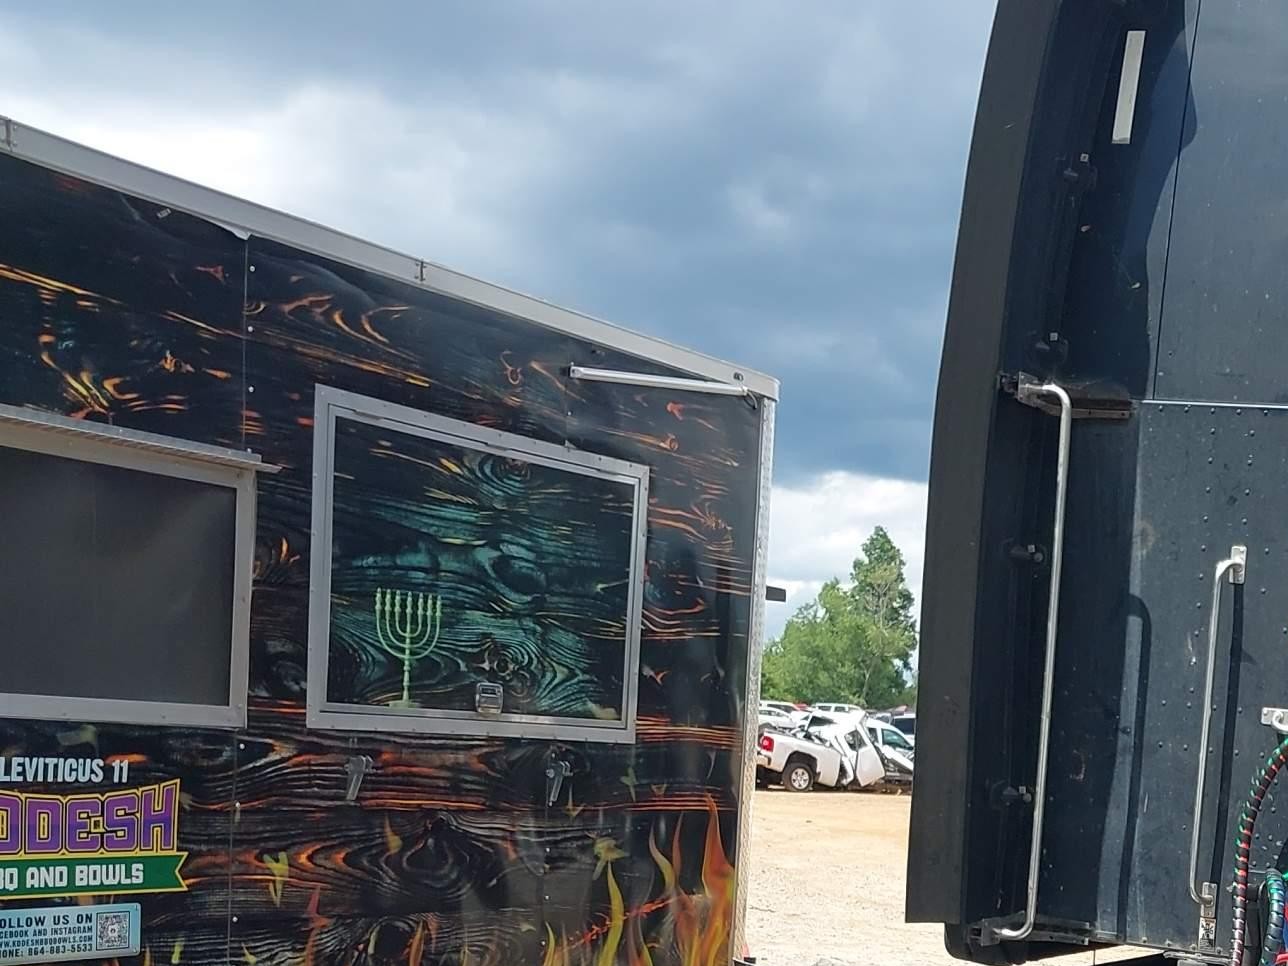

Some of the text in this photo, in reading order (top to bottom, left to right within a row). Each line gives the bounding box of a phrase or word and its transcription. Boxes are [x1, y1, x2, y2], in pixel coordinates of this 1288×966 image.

[0, 756, 129, 783] LEVITICUS 11
[26, 866, 68, 889] AND
[75, 863, 144, 887] BOWLS
[53, 914, 70, 926] US
[76, 912, 93, 925] ON
[32, 928, 48, 937] AND
[50, 925, 93, 936] INSTAGRAM
